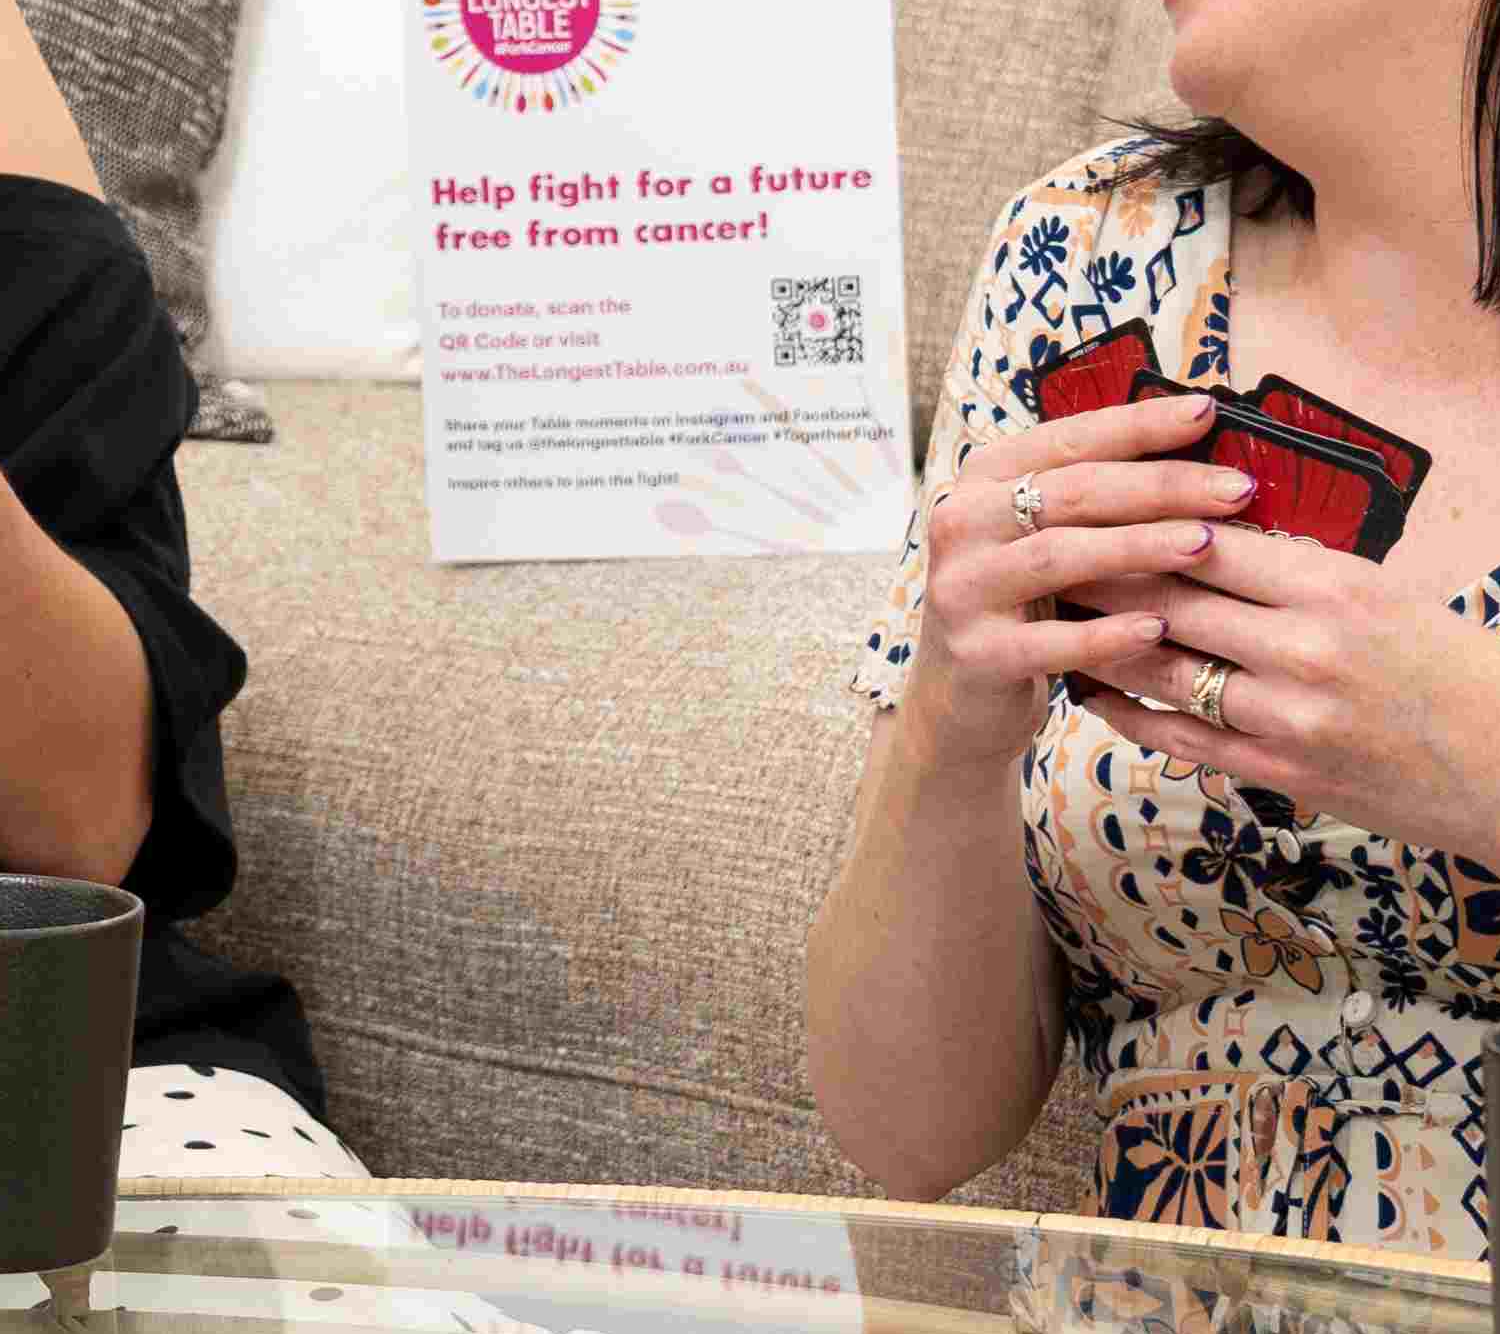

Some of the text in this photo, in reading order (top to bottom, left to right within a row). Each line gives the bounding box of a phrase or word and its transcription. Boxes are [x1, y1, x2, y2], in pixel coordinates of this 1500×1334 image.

[487, 9, 572, 40] TABLE
[432, 165, 872, 209] Help fight for a future
[435, 212, 768, 251] free from cancer!
[437, 296, 632, 320] To donate, scan the
[439, 331, 599, 351] QR Code or visit
[440, 360, 750, 383] www.TheLongestTable.com.au
[652, 417, 670, 427] on
[675, 411, 755, 427] Instagram
[760, 410, 789, 424] and
[793, 406, 873, 421] Facebook
[446, 438, 473, 452] and
[556, 476, 572, 488] to
[608, 473, 633, 487] the
